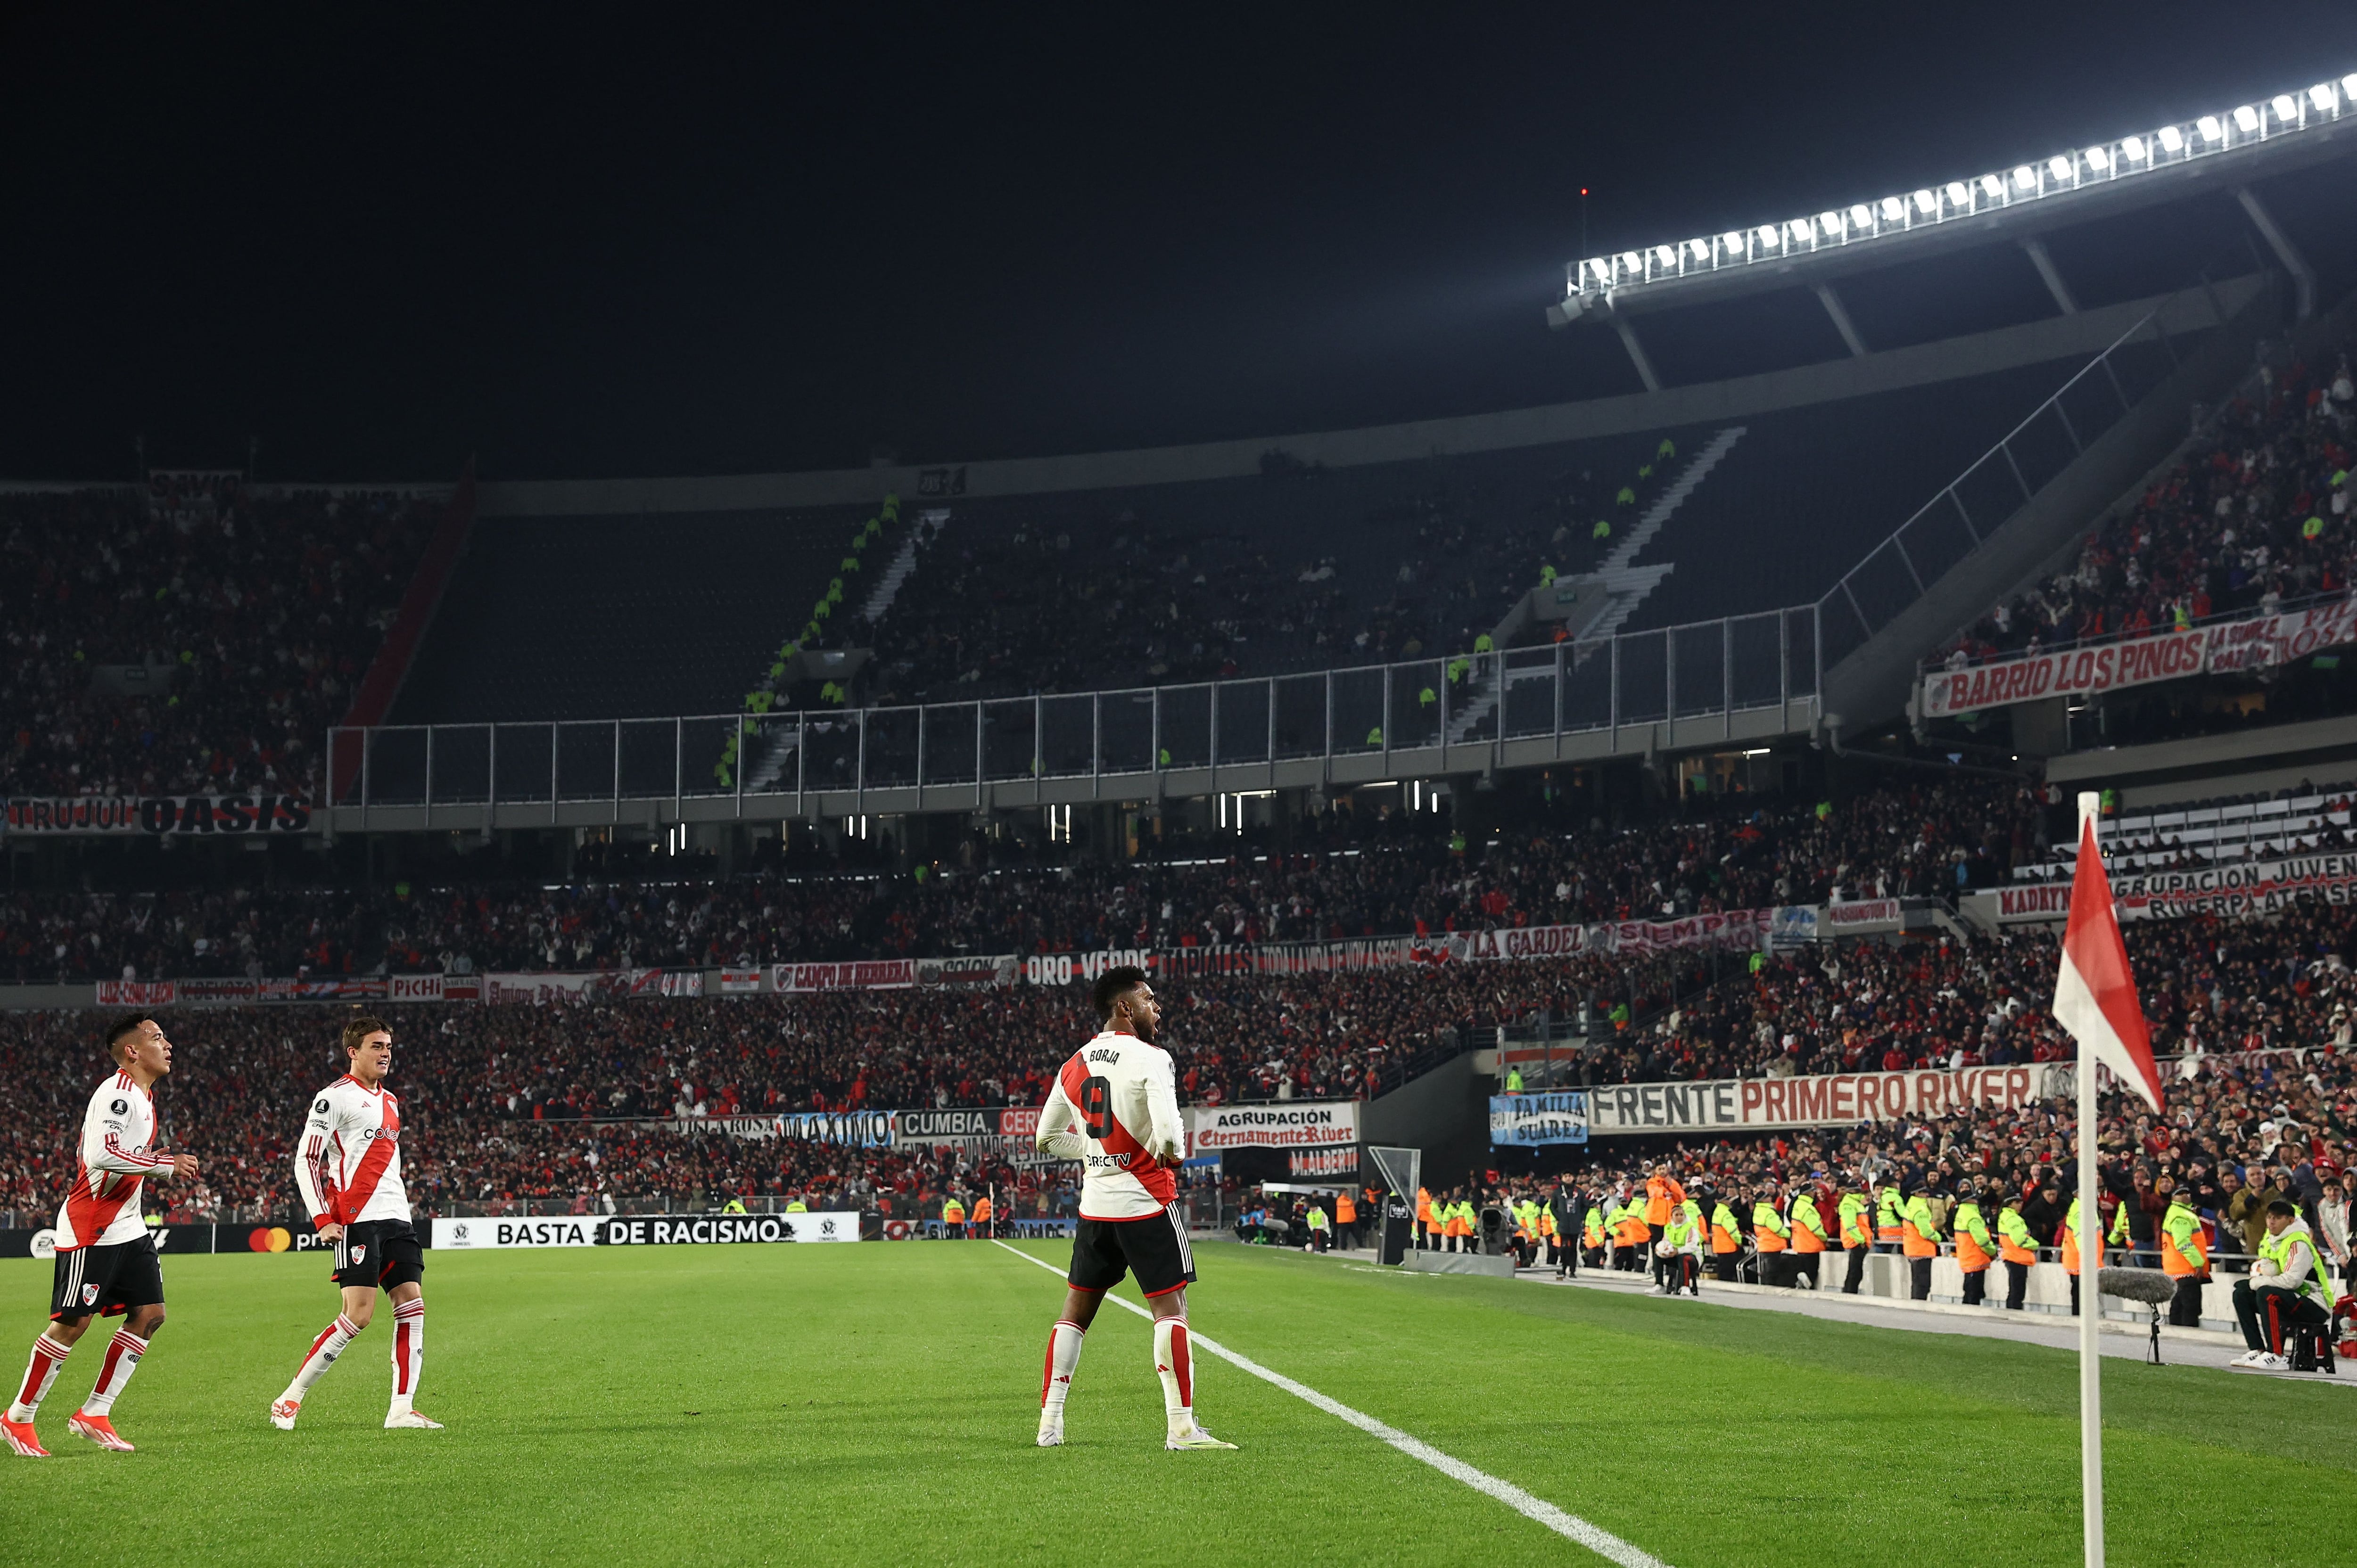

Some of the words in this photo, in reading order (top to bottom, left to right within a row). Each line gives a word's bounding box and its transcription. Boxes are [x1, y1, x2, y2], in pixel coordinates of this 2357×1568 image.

[1949, 658, 2052, 710] BARRIO
[2055, 649, 2115, 691] LOS
[2120, 633, 2204, 683] PINOS
[10, 800, 126, 830] TRUJUI
[142, 796, 310, 833] OASIS
[2109, 866, 2259, 898] GRUPACION
[1474, 932, 1499, 957] LA
[1508, 927, 1582, 955] GARDEL
[795, 965, 836, 987] CAMPO
[838, 964, 853, 986] DE
[855, 961, 912, 985] HERRERA
[1027, 954, 1072, 986] ORO
[1090, 1049, 1120, 1066] BORJA
[1081, 1076, 1114, 1139] 9
[1515, 1096, 1585, 1121] FAMILIA
[1593, 1083, 1735, 1125] FRENTE
[1742, 1075, 1906, 1123] PRIMERO
[1917, 1068, 2030, 1116] RIVER
[783, 1112, 890, 1144] MAXIMO
[905, 1112, 992, 1135] CUMBIA,
[1003, 1110, 1042, 1133] CER
[1218, 1108, 1332, 1127] AGRUPACIÓN
[1518, 1120, 1582, 1140] SUAREZ
[497, 1223, 585, 1245] BASTA
[609, 1222, 646, 1244] DE
[653, 1219, 780, 1244] RACISMO
